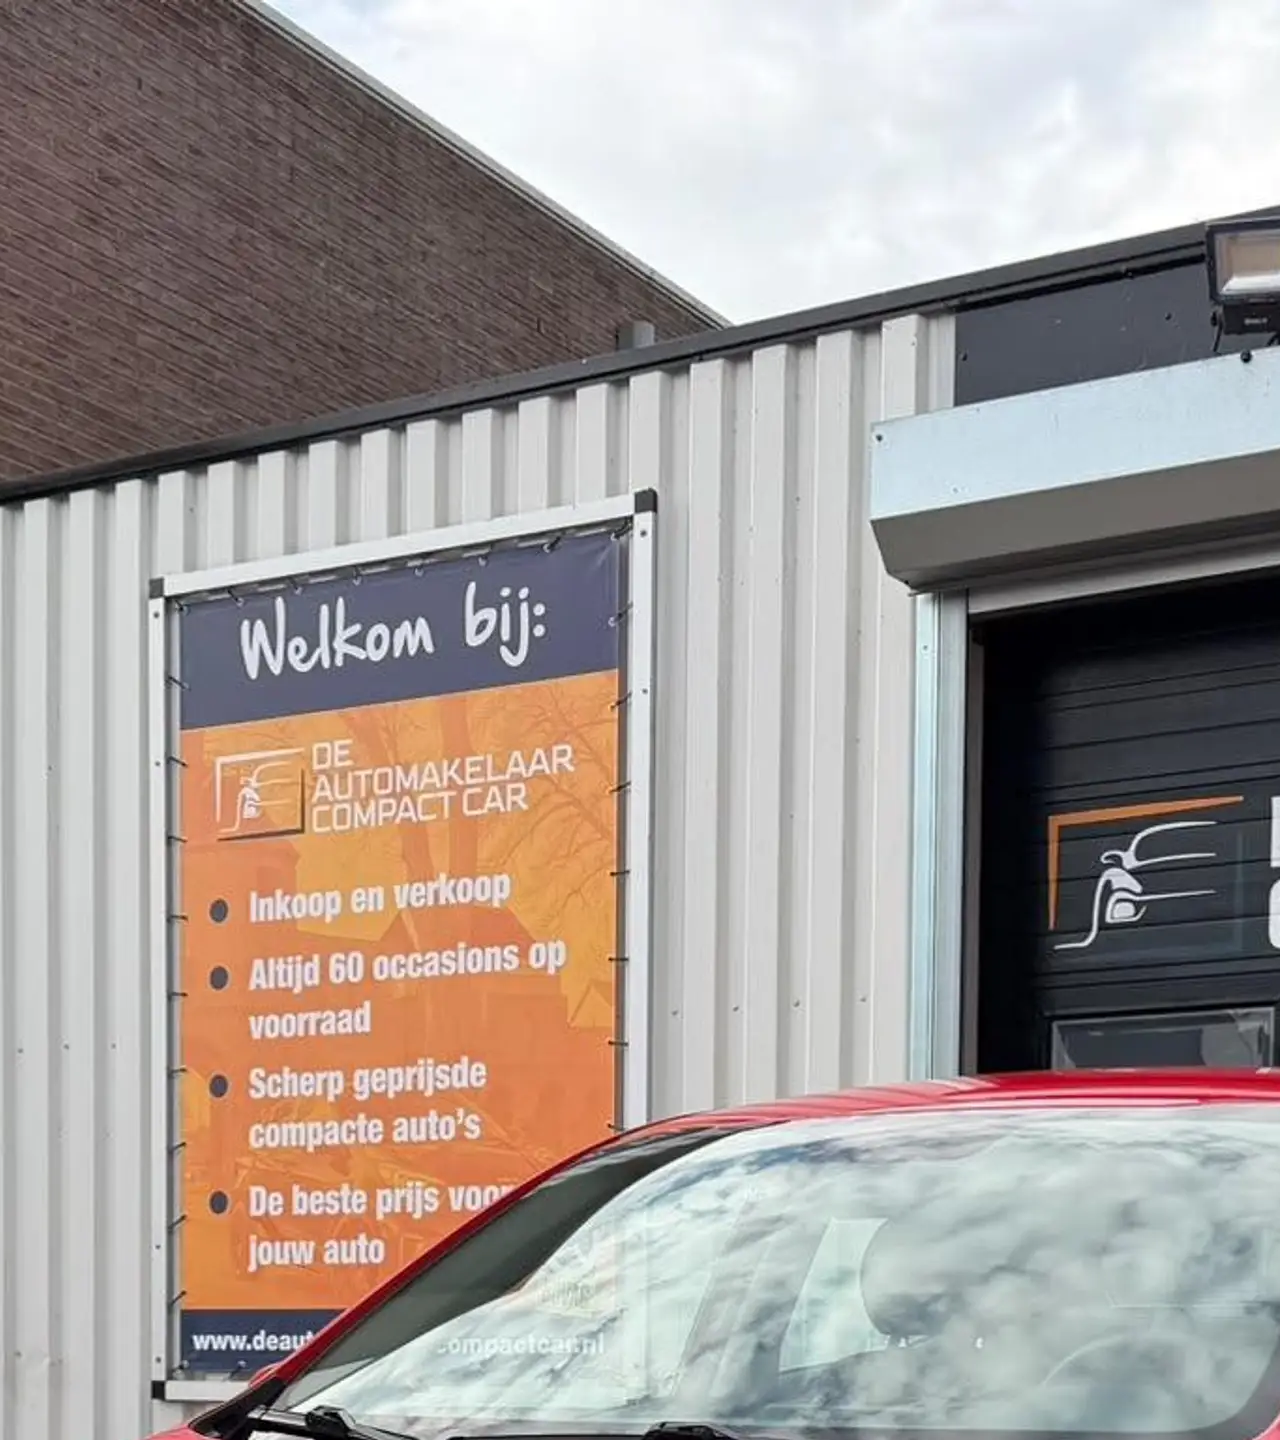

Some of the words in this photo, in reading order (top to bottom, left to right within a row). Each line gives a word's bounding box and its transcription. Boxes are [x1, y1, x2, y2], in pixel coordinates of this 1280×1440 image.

[240, 597, 434, 680] Welkom
[465, 581, 546, 666] bij:
[312, 739, 353, 771] DE
[312, 744, 574, 802] AUTOMAKELAAR
[312, 788, 457, 834] COMPACT
[462, 782, 529, 815] CAR
[249, 888, 341, 923] Inkoop
[351, 884, 385, 913] en
[393, 871, 511, 910] verkoop
[249, 955, 320, 997] Altijd
[329, 952, 364, 984] 60
[373, 940, 519, 980] occasions
[529, 937, 567, 975] op
[249, 1001, 372, 1040] voorraad
[249, 1065, 343, 1102] Scherp
[353, 1056, 487, 1102] geprijsde
[249, 1113, 383, 1153] compacte
[392, 1108, 480, 1142] auto's
[249, 1185, 284, 1217] De
[291, 1183, 367, 1216] beste
[376, 1183, 439, 1220] prijs
[248, 1237, 315, 1271] jouw
[324, 1232, 385, 1265] auto
